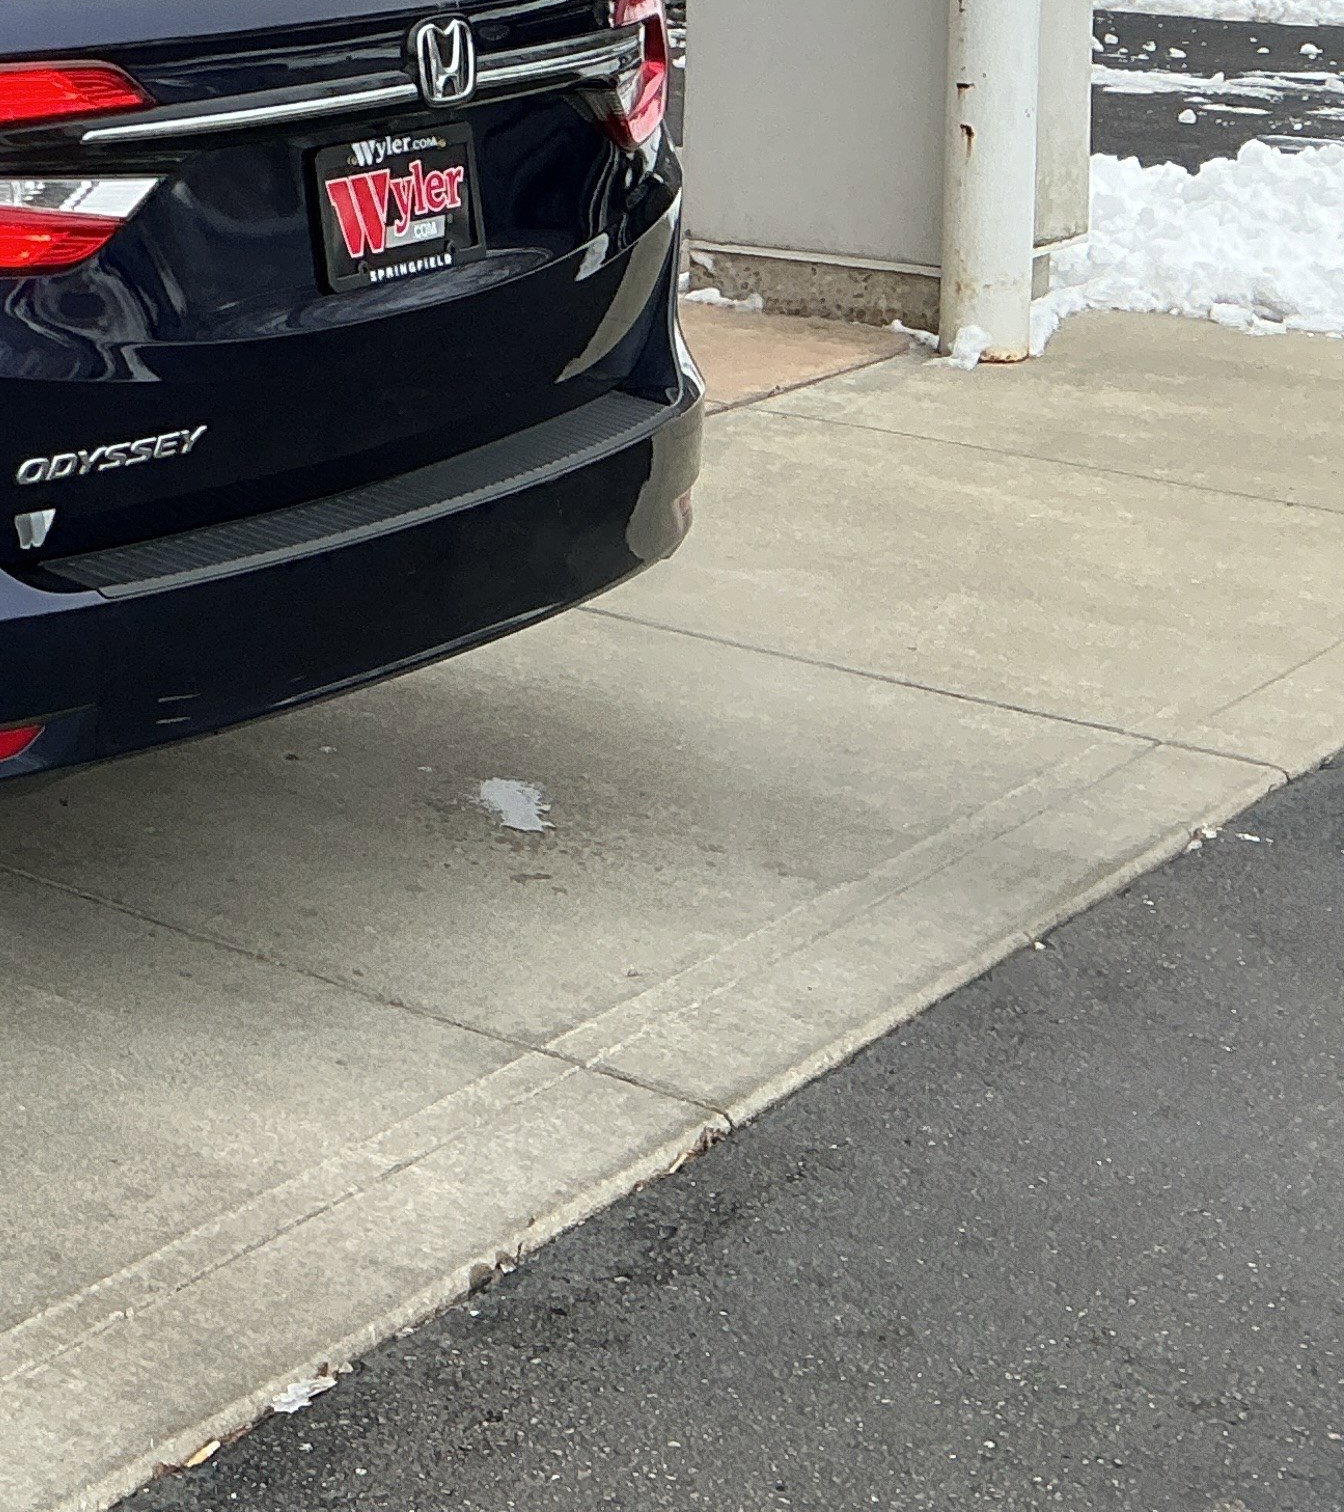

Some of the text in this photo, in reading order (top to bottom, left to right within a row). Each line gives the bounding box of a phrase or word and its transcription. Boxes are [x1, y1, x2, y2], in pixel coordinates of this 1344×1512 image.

[325, 159, 464, 259] Wyler
[369, 253, 453, 282] SPRINGFIELD
[15, 424, 208, 486] ODYSSEY
